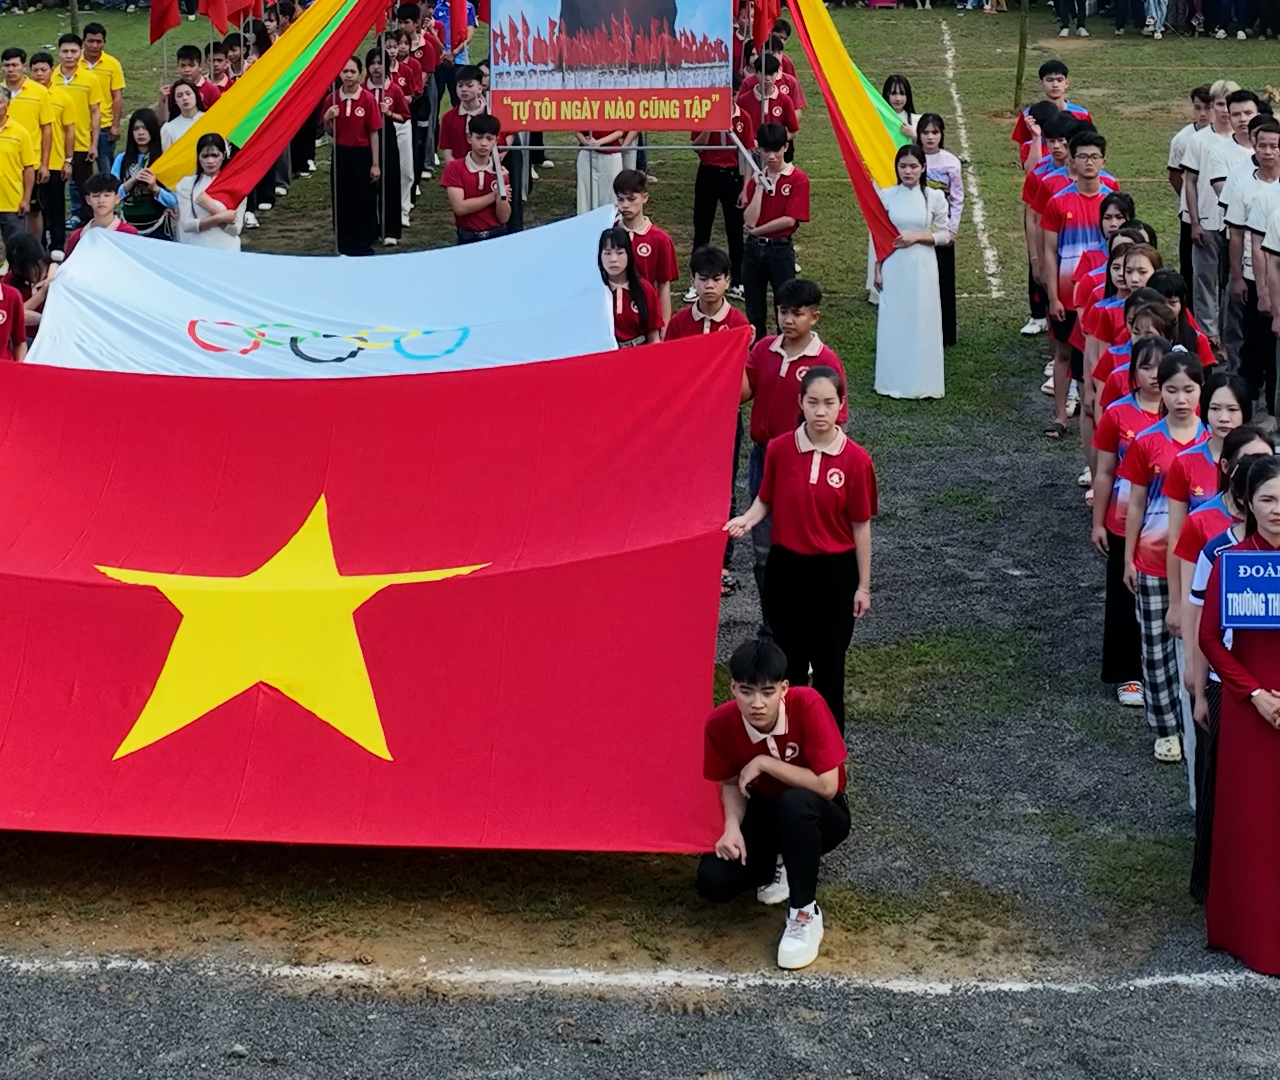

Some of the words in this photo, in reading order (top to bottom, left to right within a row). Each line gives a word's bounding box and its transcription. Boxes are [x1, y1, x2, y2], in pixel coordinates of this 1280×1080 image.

[533, 97, 557, 121] TÔI
[560, 96, 601, 120] NGÀY
[604, 96, 635, 120] NÀO
[639, 96, 680, 119] CŨNG
[1227, 587, 1266, 616] TRƯỜNG
